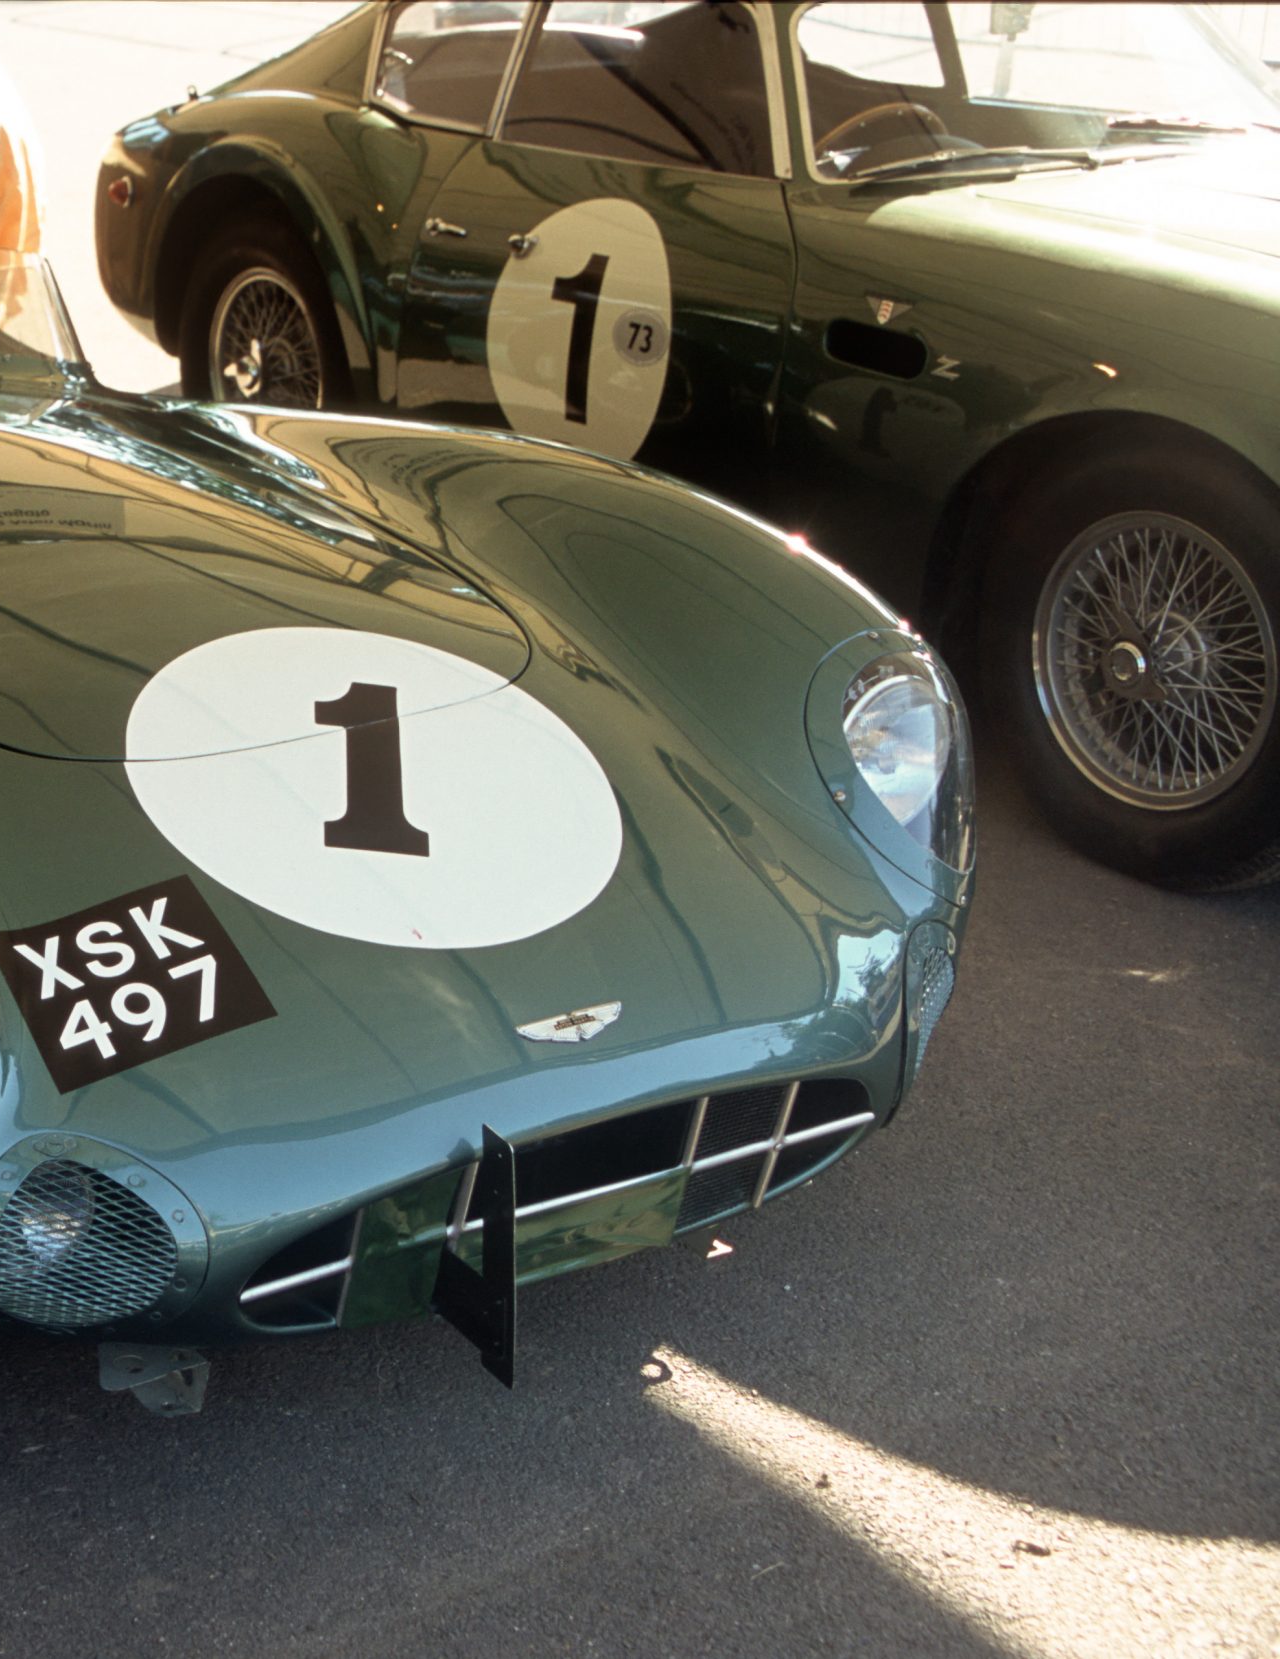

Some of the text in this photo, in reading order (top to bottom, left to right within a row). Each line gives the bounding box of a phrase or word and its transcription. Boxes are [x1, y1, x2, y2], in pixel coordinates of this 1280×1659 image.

[552, 253, 610, 425] 1
[628, 322, 653, 353] 73
[314, 682, 430, 857] 1
[13, 897, 205, 999] XSK
[60, 955, 217, 1059] 497
